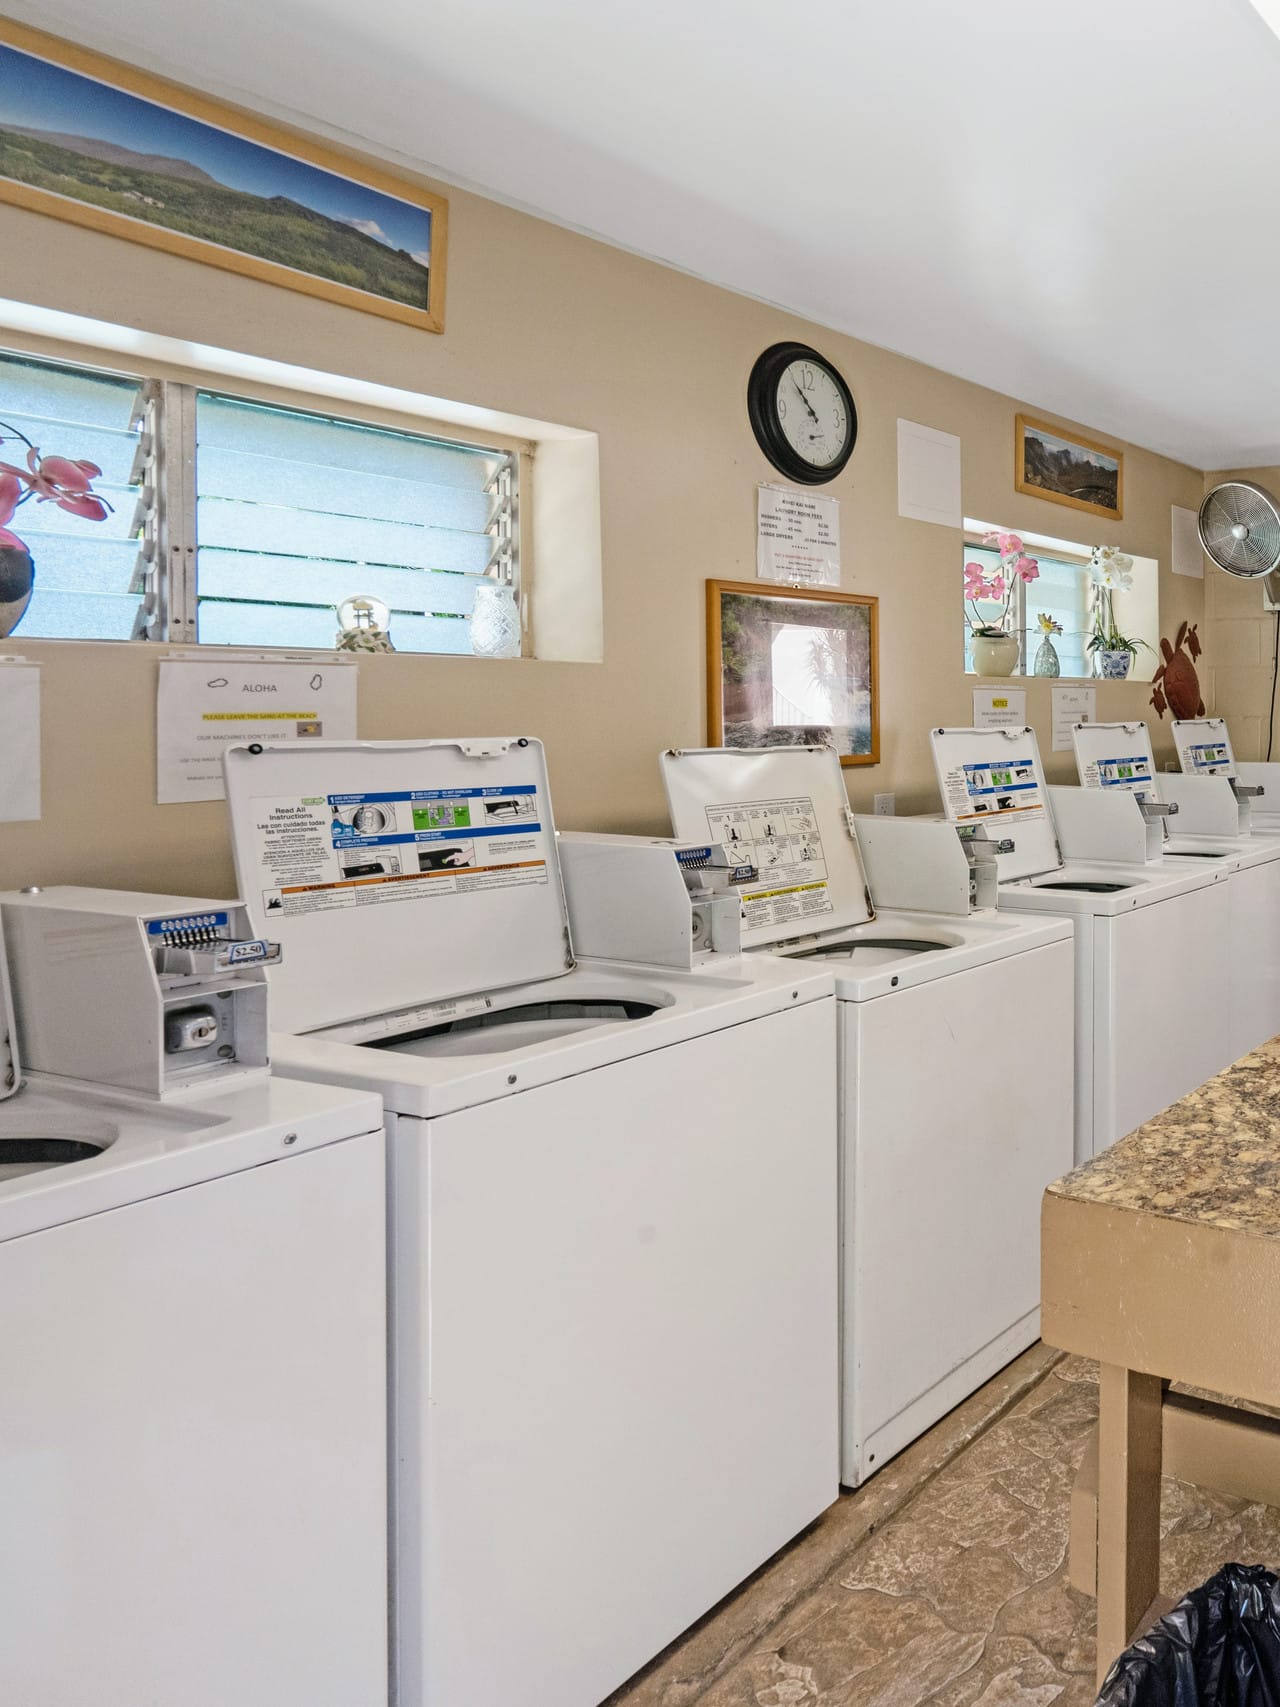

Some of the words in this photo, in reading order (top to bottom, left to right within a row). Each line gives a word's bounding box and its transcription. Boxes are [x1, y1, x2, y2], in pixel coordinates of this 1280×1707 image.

[801, 370, 814, 391] 12
[779, 400, 786, 420] 9
[832, 409, 840, 428] 3
[242, 684, 277, 692] ALOHA
[235, 944, 261, 957] $2.50
